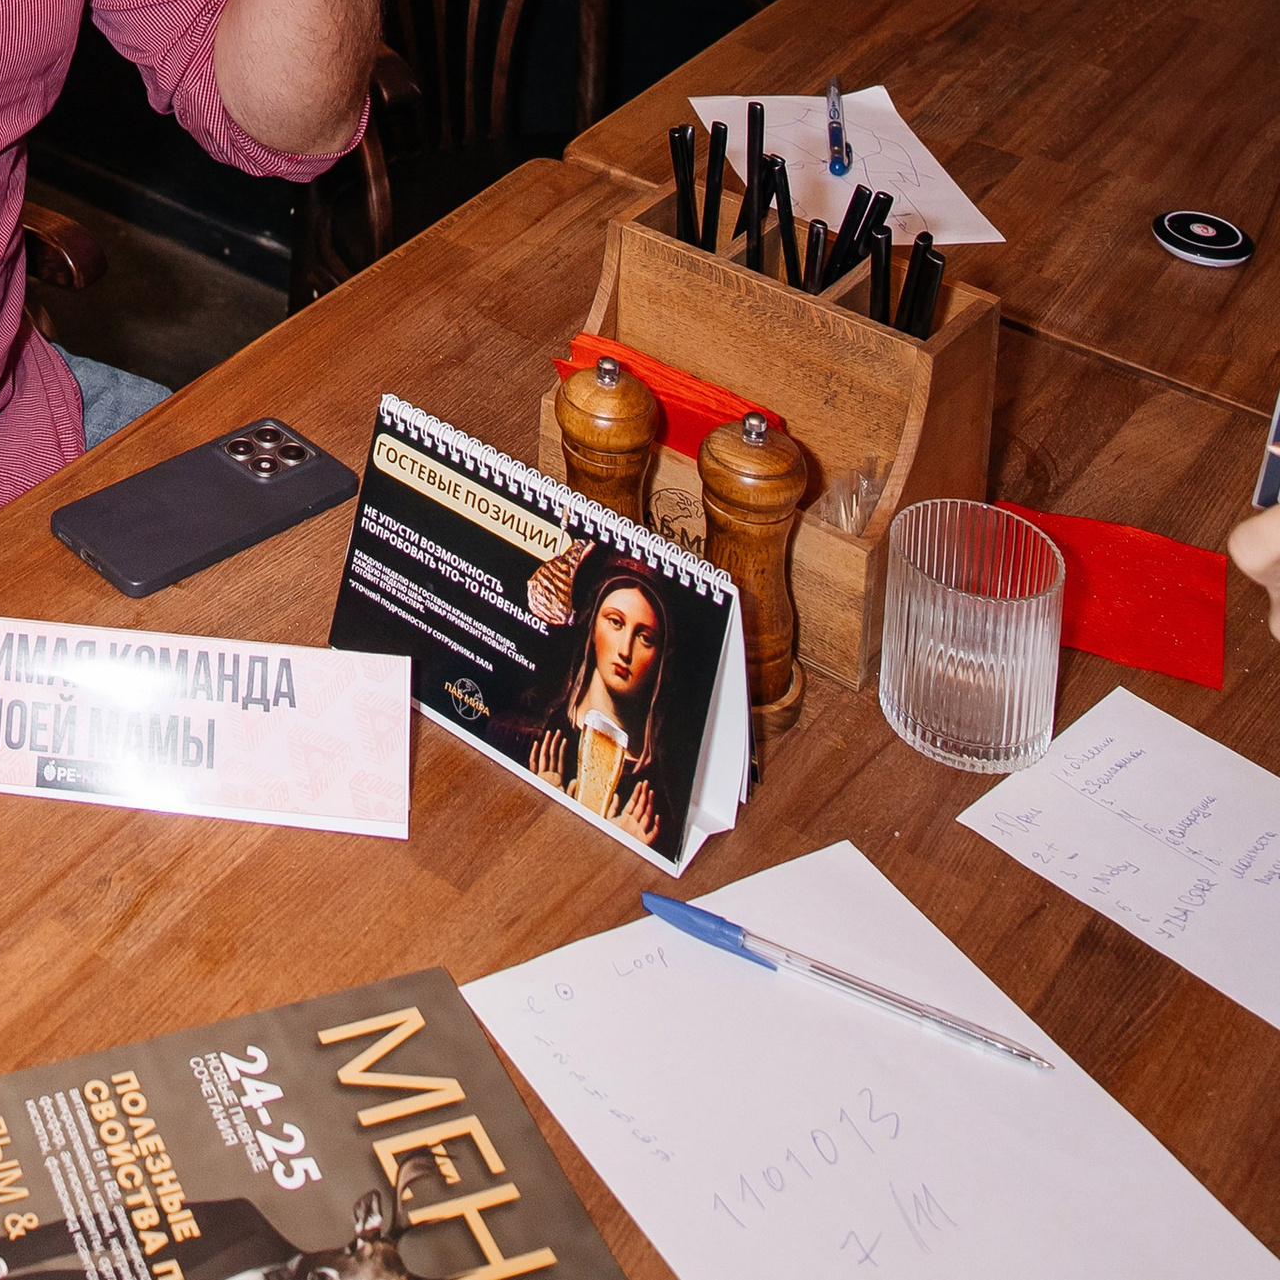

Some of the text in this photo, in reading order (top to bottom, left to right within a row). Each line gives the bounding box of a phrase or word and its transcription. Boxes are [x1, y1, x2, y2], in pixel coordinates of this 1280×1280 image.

[363, 504, 504, 593] НЕ УПУСТИ ВОЗМОЖНОСТЬ
[376, 441, 558, 553] ГОСТЕВЫЕ ПОЗИЦИИ
[351, 563, 380, 587] ГОТОВИТ
[380, 579, 392, 593] ЕГО
[397, 589, 425, 613] ХОСПЕРЕ.
[353, 556, 380, 580] КАЖДУЮ
[381, 573, 407, 596] НЕДЕЛЮ
[408, 589, 447, 620] ШЕФ-ПОВАР
[447, 612, 482, 641] ПРИВОЗИТ
[482, 634, 508, 657] НОВЫЙ
[507, 649, 529, 669] СТЕЙК
[354, 549, 517, 650] КАЖДУЮ НЕДЕЛЮ НА ГОСТЕВОМ КРАНЕ НОВОЕ ПИВО.
[361, 516, 550, 636] ПОПРОБОВАТЬ ЧТО-ТО НОВЕНЬКОЕ.
[381, 598, 427, 632] ПОДРОБНОСТИ
[432, 628, 474, 660] СОТРУДНИКА
[475, 653, 493, 671] ЗАЛА
[88, 707, 216, 770] МАМЫ
[444, 681, 490, 716] ПАБ МИРА
[189, 1056, 239, 1146] СОЧЕТАНИЯ
[204, 1052, 269, 1174] НОВЫЕ ПИВНЫЕ
[220, 1045, 323, 1189] 24-25
[318, 1006, 558, 1280] МЕН
[84, 1079, 170, 1256] СВОЙСТВА
[110, 1070, 201, 1243] ПОЛЕЗНЫЕ
[4, 1212, 39, 1241] &
